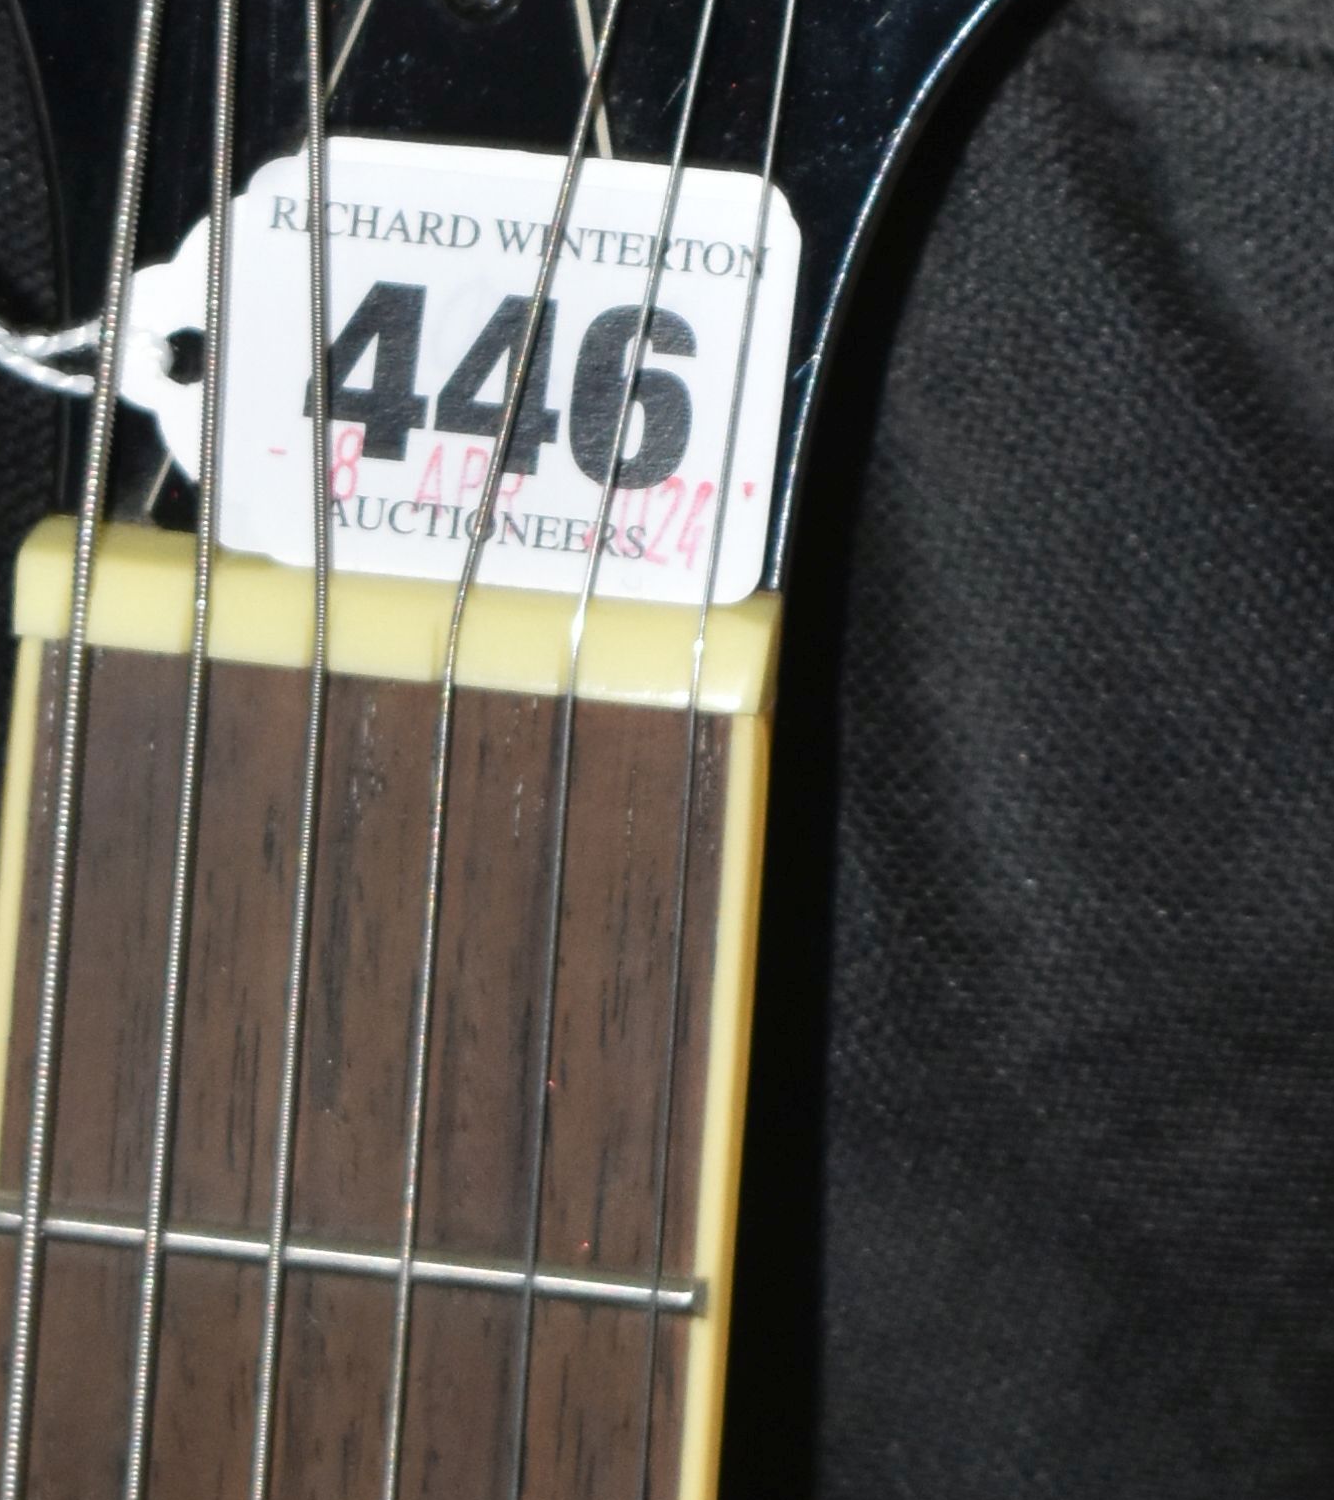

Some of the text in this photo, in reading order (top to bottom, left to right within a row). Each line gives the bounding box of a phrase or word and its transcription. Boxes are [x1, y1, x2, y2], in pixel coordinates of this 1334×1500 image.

[270, 195, 771, 279] RICHARD WINTERTON
[302, 280, 697, 490] 446
[327, 495, 647, 560] AUCTIONEERS
